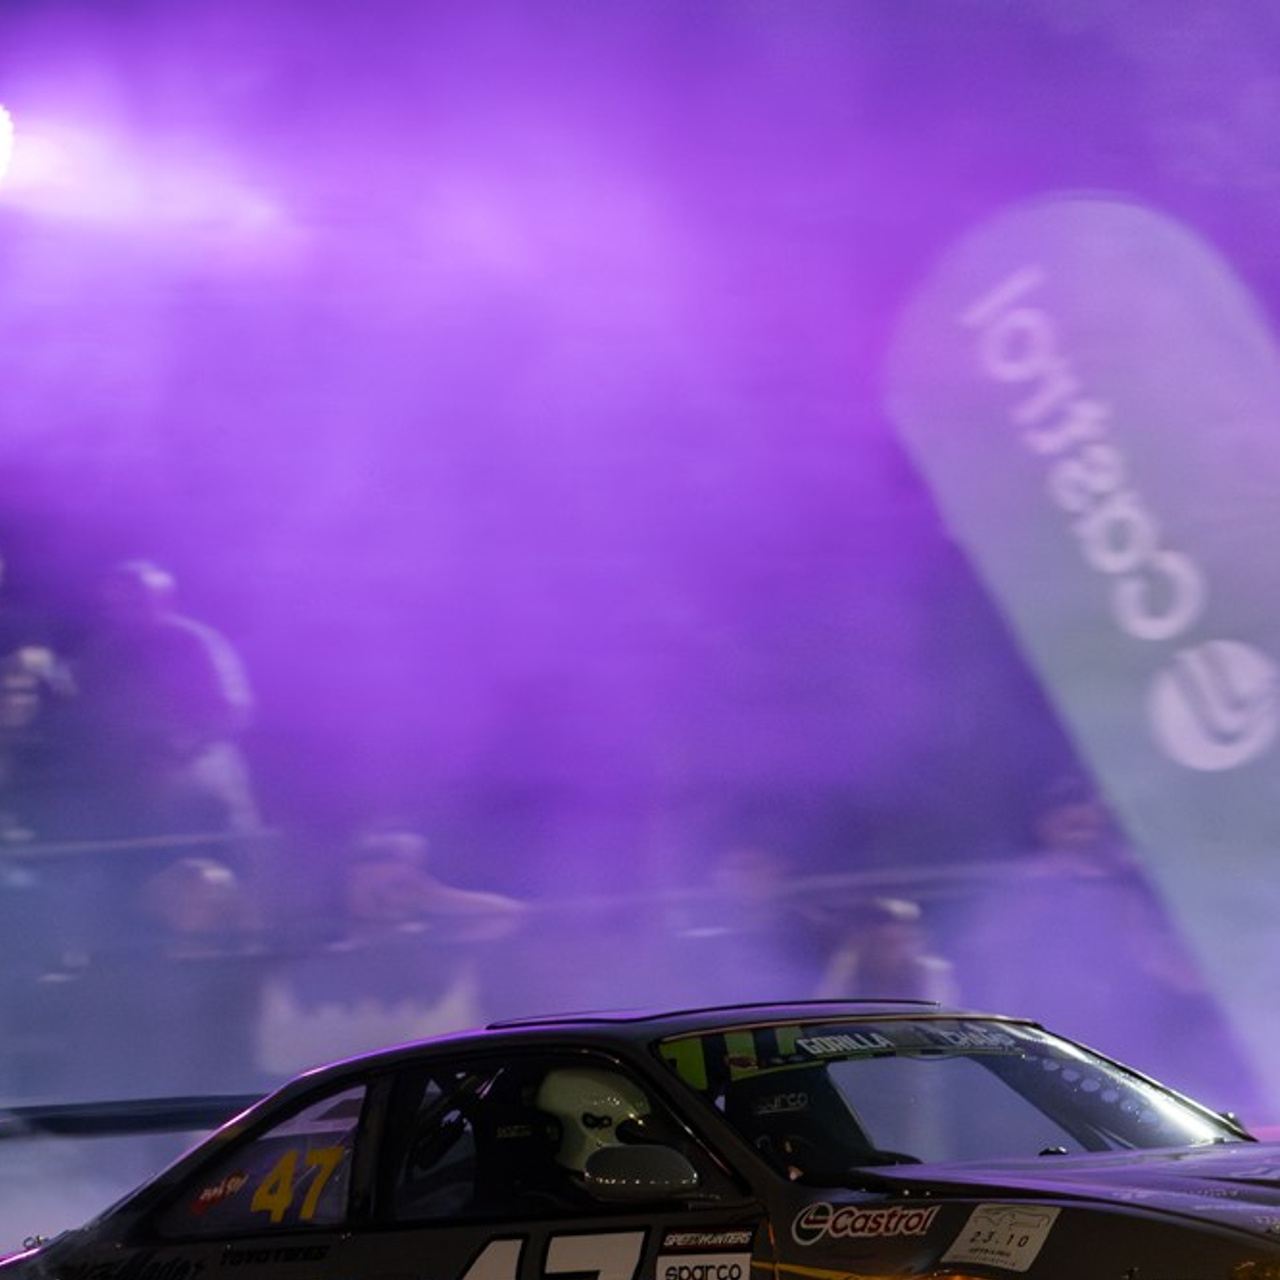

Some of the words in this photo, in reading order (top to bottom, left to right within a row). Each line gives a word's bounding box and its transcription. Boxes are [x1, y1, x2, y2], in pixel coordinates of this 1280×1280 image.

[796, 1032, 896, 1055] GORILLA
[250, 1146, 344, 1223] 47
[829, 1206, 940, 1237] Castrol
